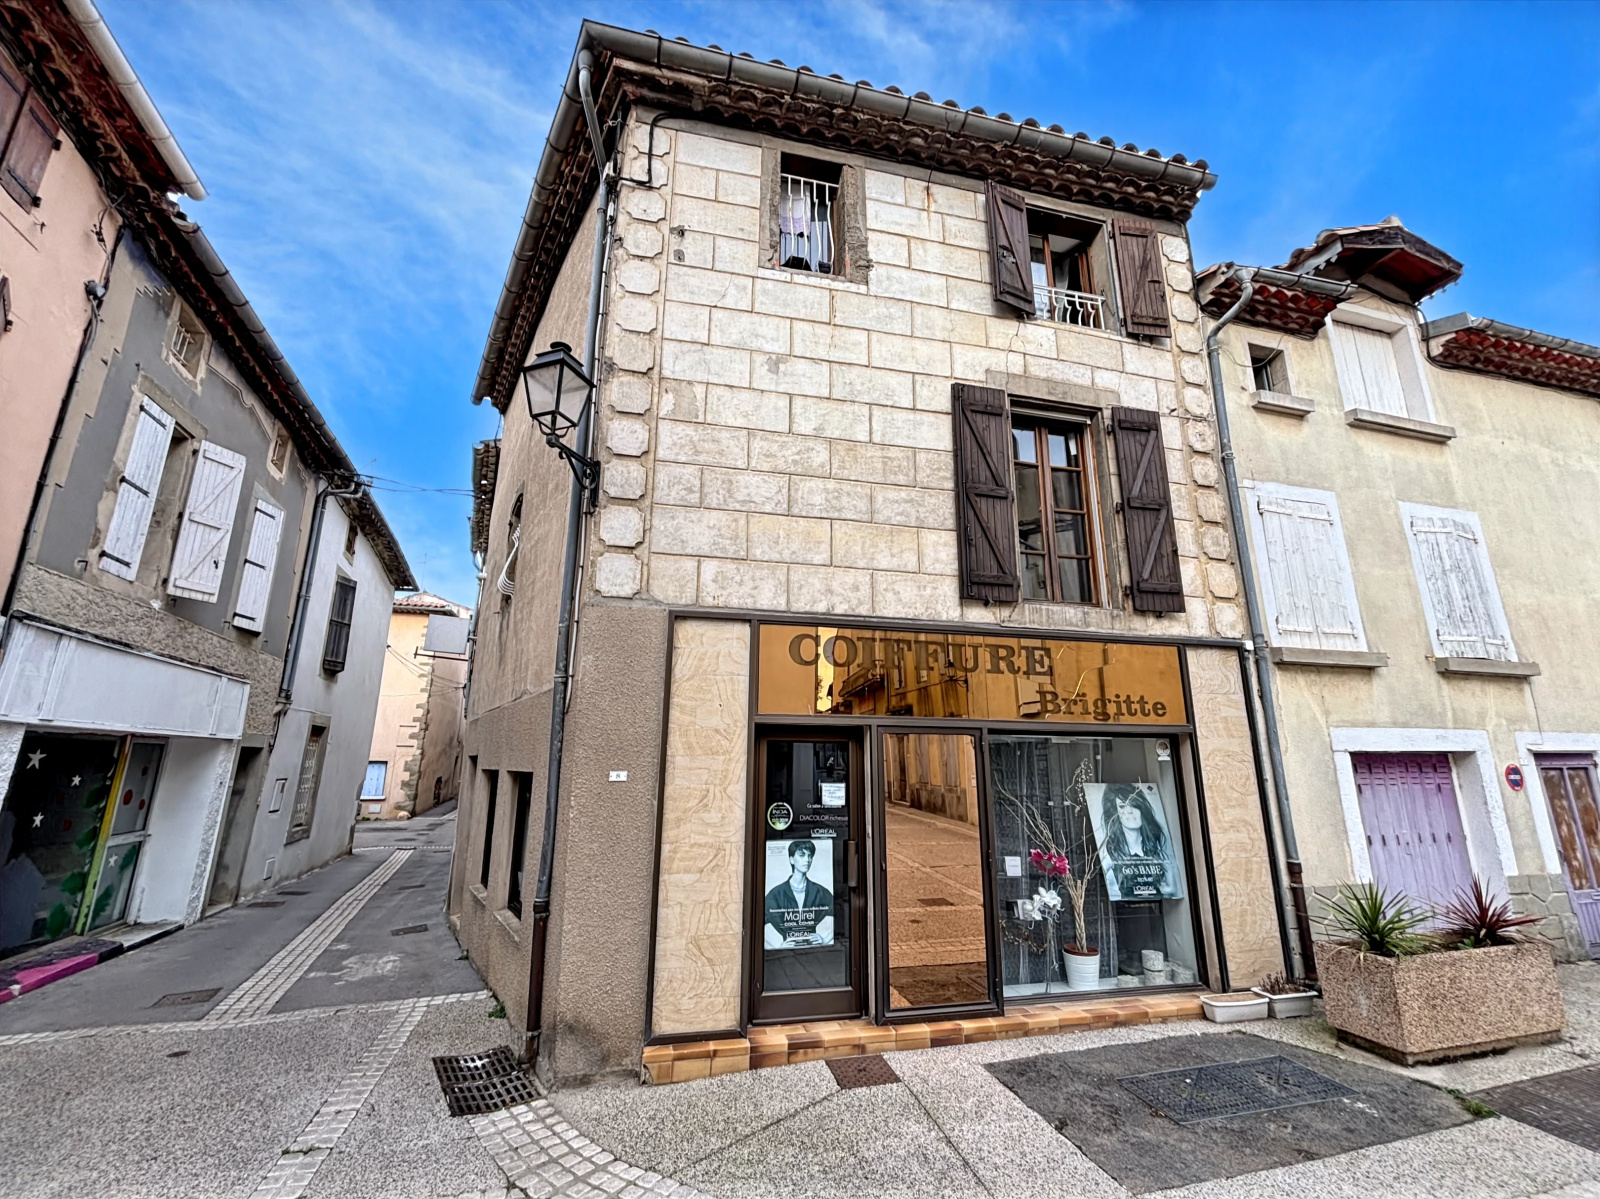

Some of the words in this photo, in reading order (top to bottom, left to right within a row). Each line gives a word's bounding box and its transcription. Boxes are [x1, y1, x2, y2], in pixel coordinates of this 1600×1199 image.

[788, 633, 1054, 677] COIFFURE
[1036, 690, 1167, 721] Brigitte
[1122, 865, 1139, 874] 60's
[1140, 865, 1162, 874] BABE
[784, 910, 815, 922] Majirel
